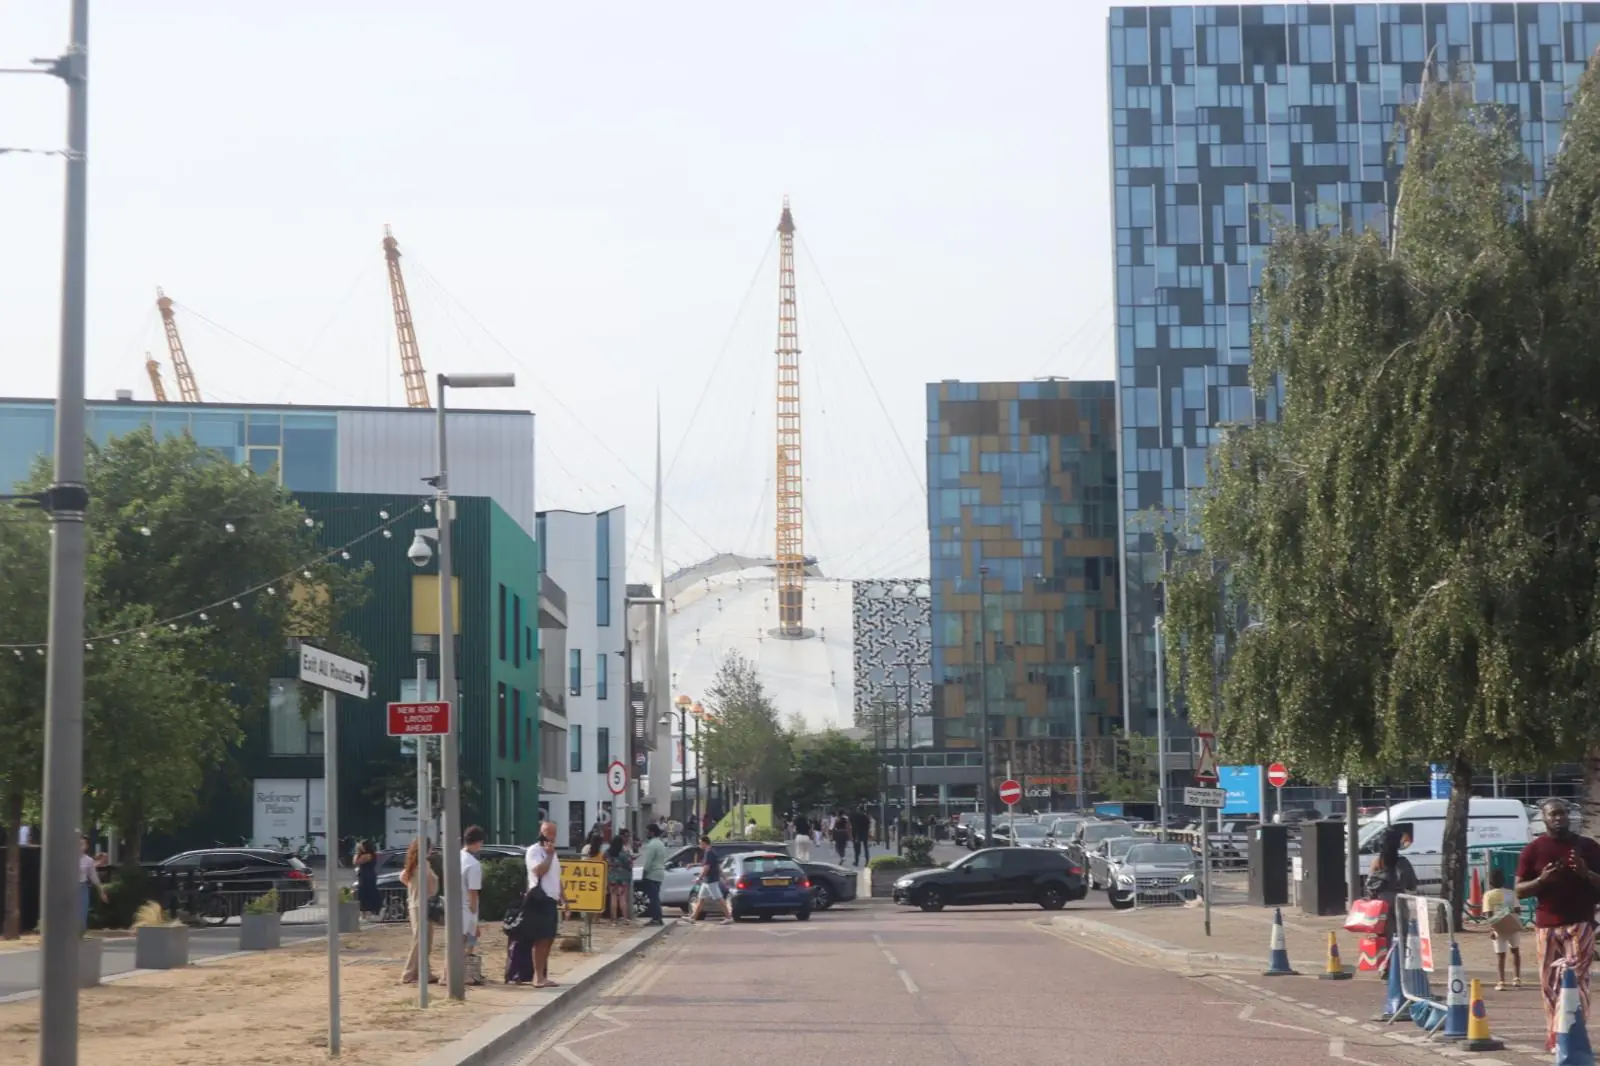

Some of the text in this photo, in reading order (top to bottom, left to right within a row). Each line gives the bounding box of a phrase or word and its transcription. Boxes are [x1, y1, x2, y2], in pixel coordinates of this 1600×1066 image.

[303, 653, 353, 684] Exit All Routes
[397, 705, 440, 714] NEW ROAD
[403, 714, 433, 723] LAYOUT
[405, 724, 433, 732] AHEAD
[613, 771, 621, 786] 5
[1025, 786, 1051, 798] Local
[572, 866, 599, 877] ALL
[561, 880, 598, 892] UTES
